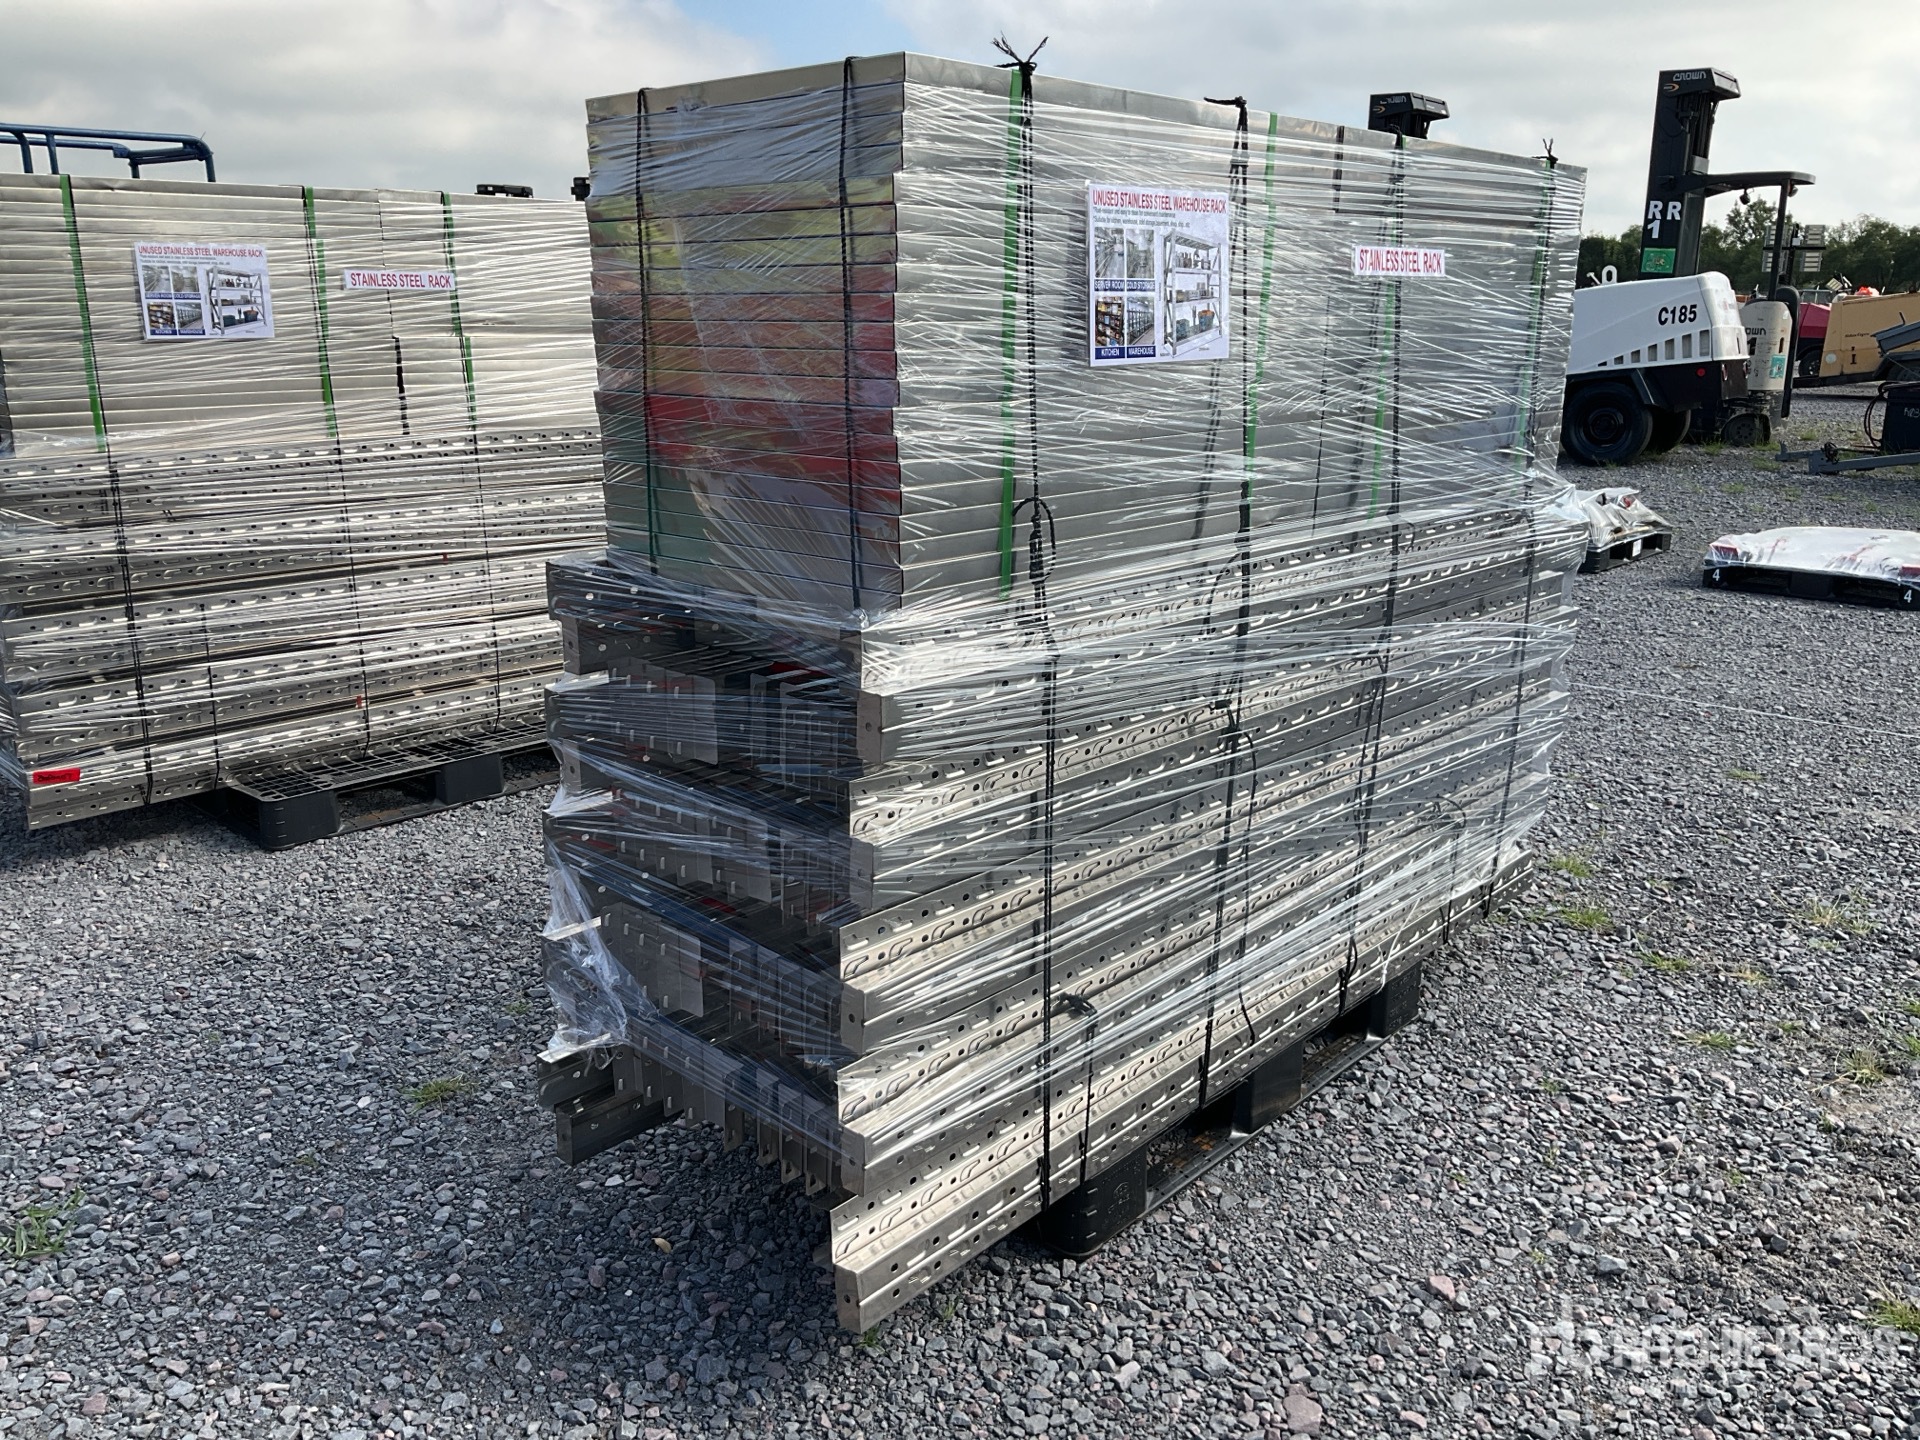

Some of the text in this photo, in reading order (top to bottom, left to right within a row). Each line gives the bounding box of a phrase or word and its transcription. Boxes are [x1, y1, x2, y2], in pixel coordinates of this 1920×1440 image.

[1672, 71, 1707, 82] CROWN
[1093, 190, 1118, 207] UNUSED
[1120, 192, 1153, 210] STAINLESS
[1154, 195, 1172, 211] STEEL
[1173, 197, 1210, 213] WAREHOUSE
[1210, 198, 1227, 213] RACK
[1647, 219, 1660, 239] 1
[139, 246, 162, 255] UNUSED
[164, 247, 194, 256] STAINLESS
[195, 248, 212, 257] STEEL
[212, 248, 248, 258] WAREHOUSE
[248, 249, 263, 258] RACK
[1359, 248, 1442, 273] STAINLESS STEEL RACK
[350, 272, 451, 288] STAINLESS STEEL RACK
[1657, 303, 1698, 325] C185
[1101, 347, 1154, 356] KITCHEN WAREHOUSE
[1712, 568, 1720, 581] 4
[1903, 589, 1913, 604] 4
